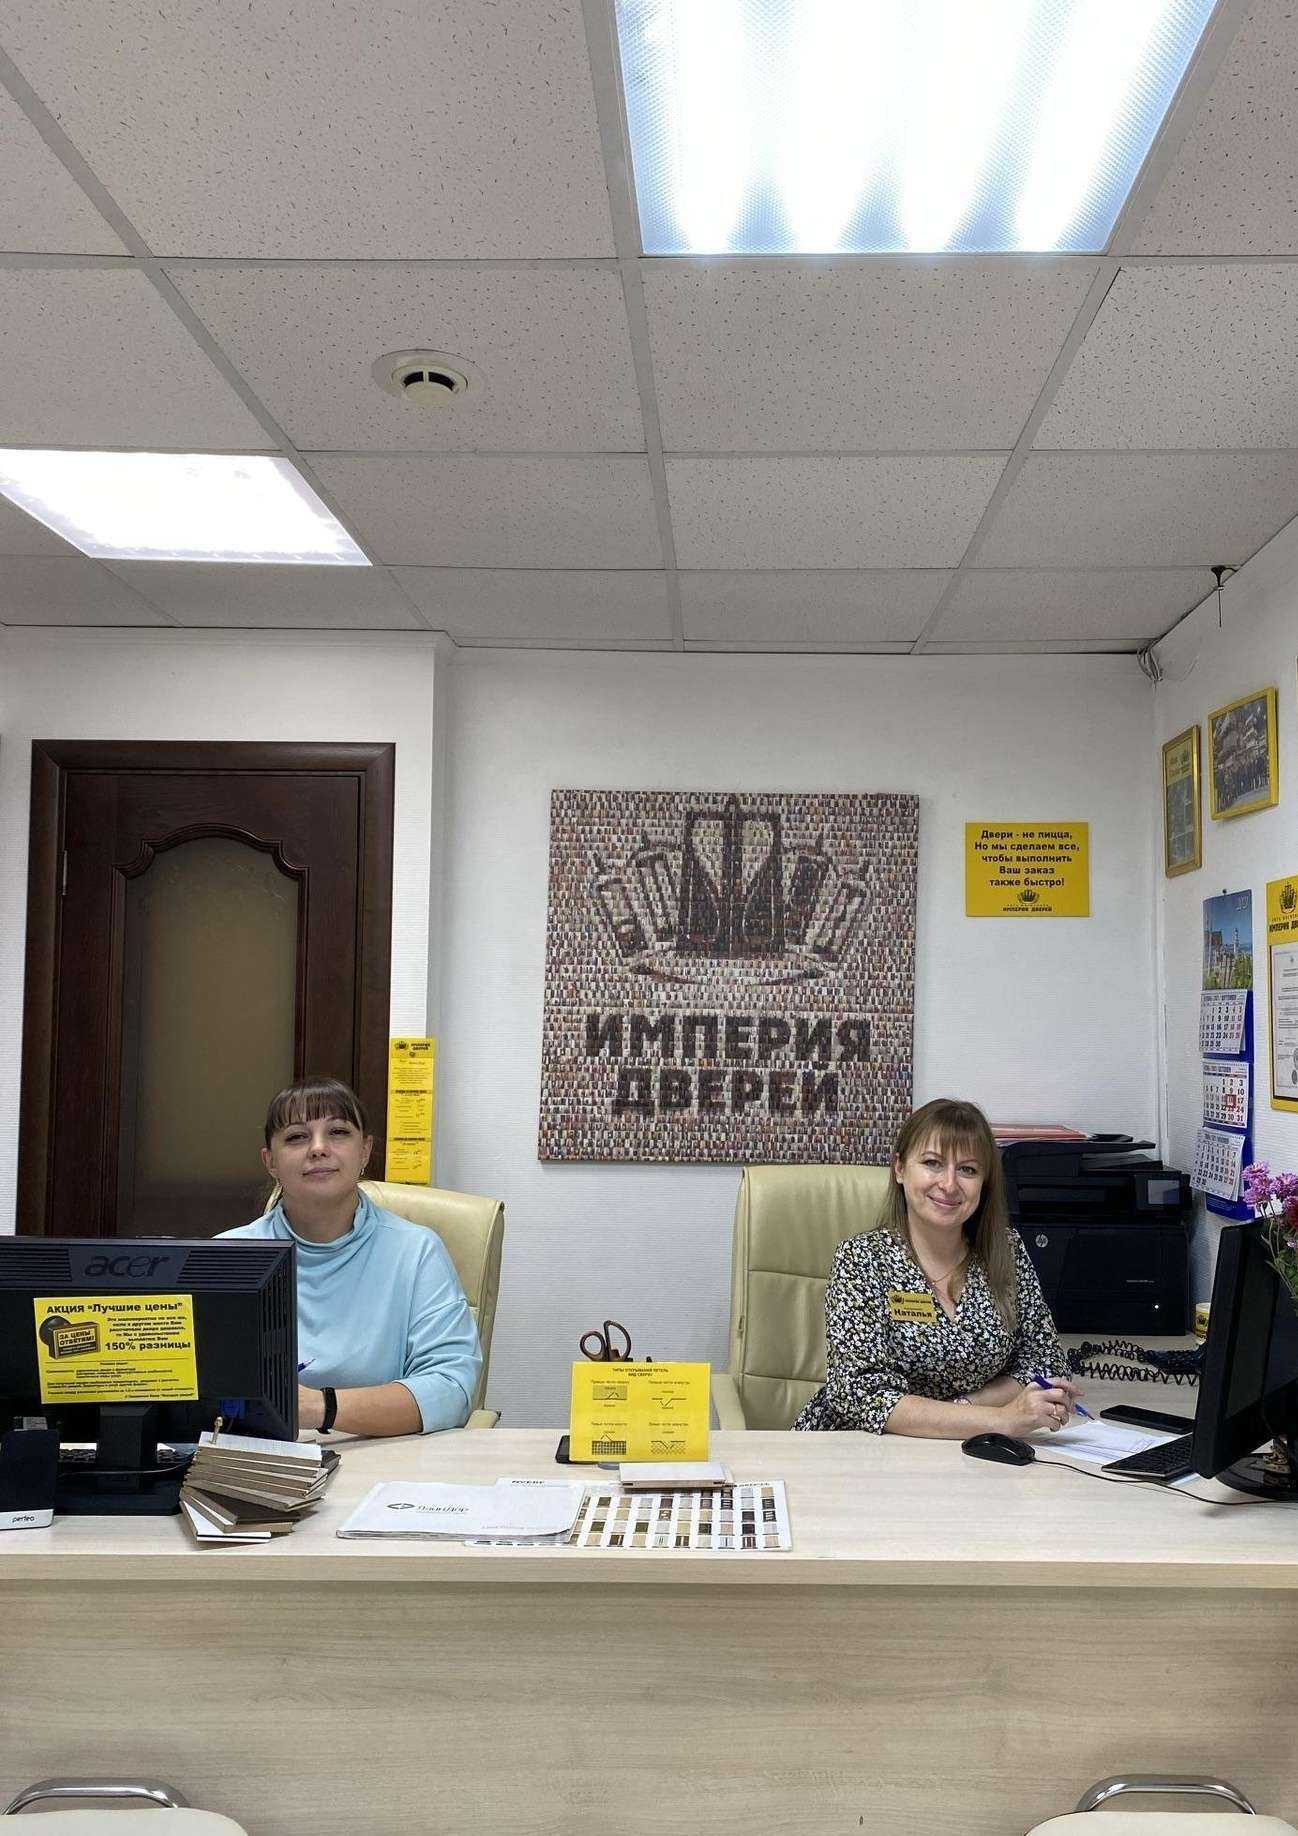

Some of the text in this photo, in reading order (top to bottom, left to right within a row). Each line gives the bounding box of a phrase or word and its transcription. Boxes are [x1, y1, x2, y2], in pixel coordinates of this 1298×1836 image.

[981, 830, 1013, 840] Двери
[1038, 831, 1072, 840] пицца,
[975, 842, 988, 850] Но
[1010, 843, 1056, 851] сделаем
[1058, 843, 1080, 851] все,
[982, 854, 1012, 862] чтобы
[1000, 866, 1021, 874] Ваш
[1024, 878, 1065, 888] быстро!
[586, 1013, 871, 1063] ИМПЕРИЯ
[612, 1061, 840, 1115] ДВЕРЕЙ
[85, 1255, 170, 1278] acer
[47, 1306, 85, 1315] АКЦИЯ
[894, 1309, 932, 1317] Наталья
[106, 1342, 136, 1350] 150%
[139, 1342, 191, 1351] разницы
